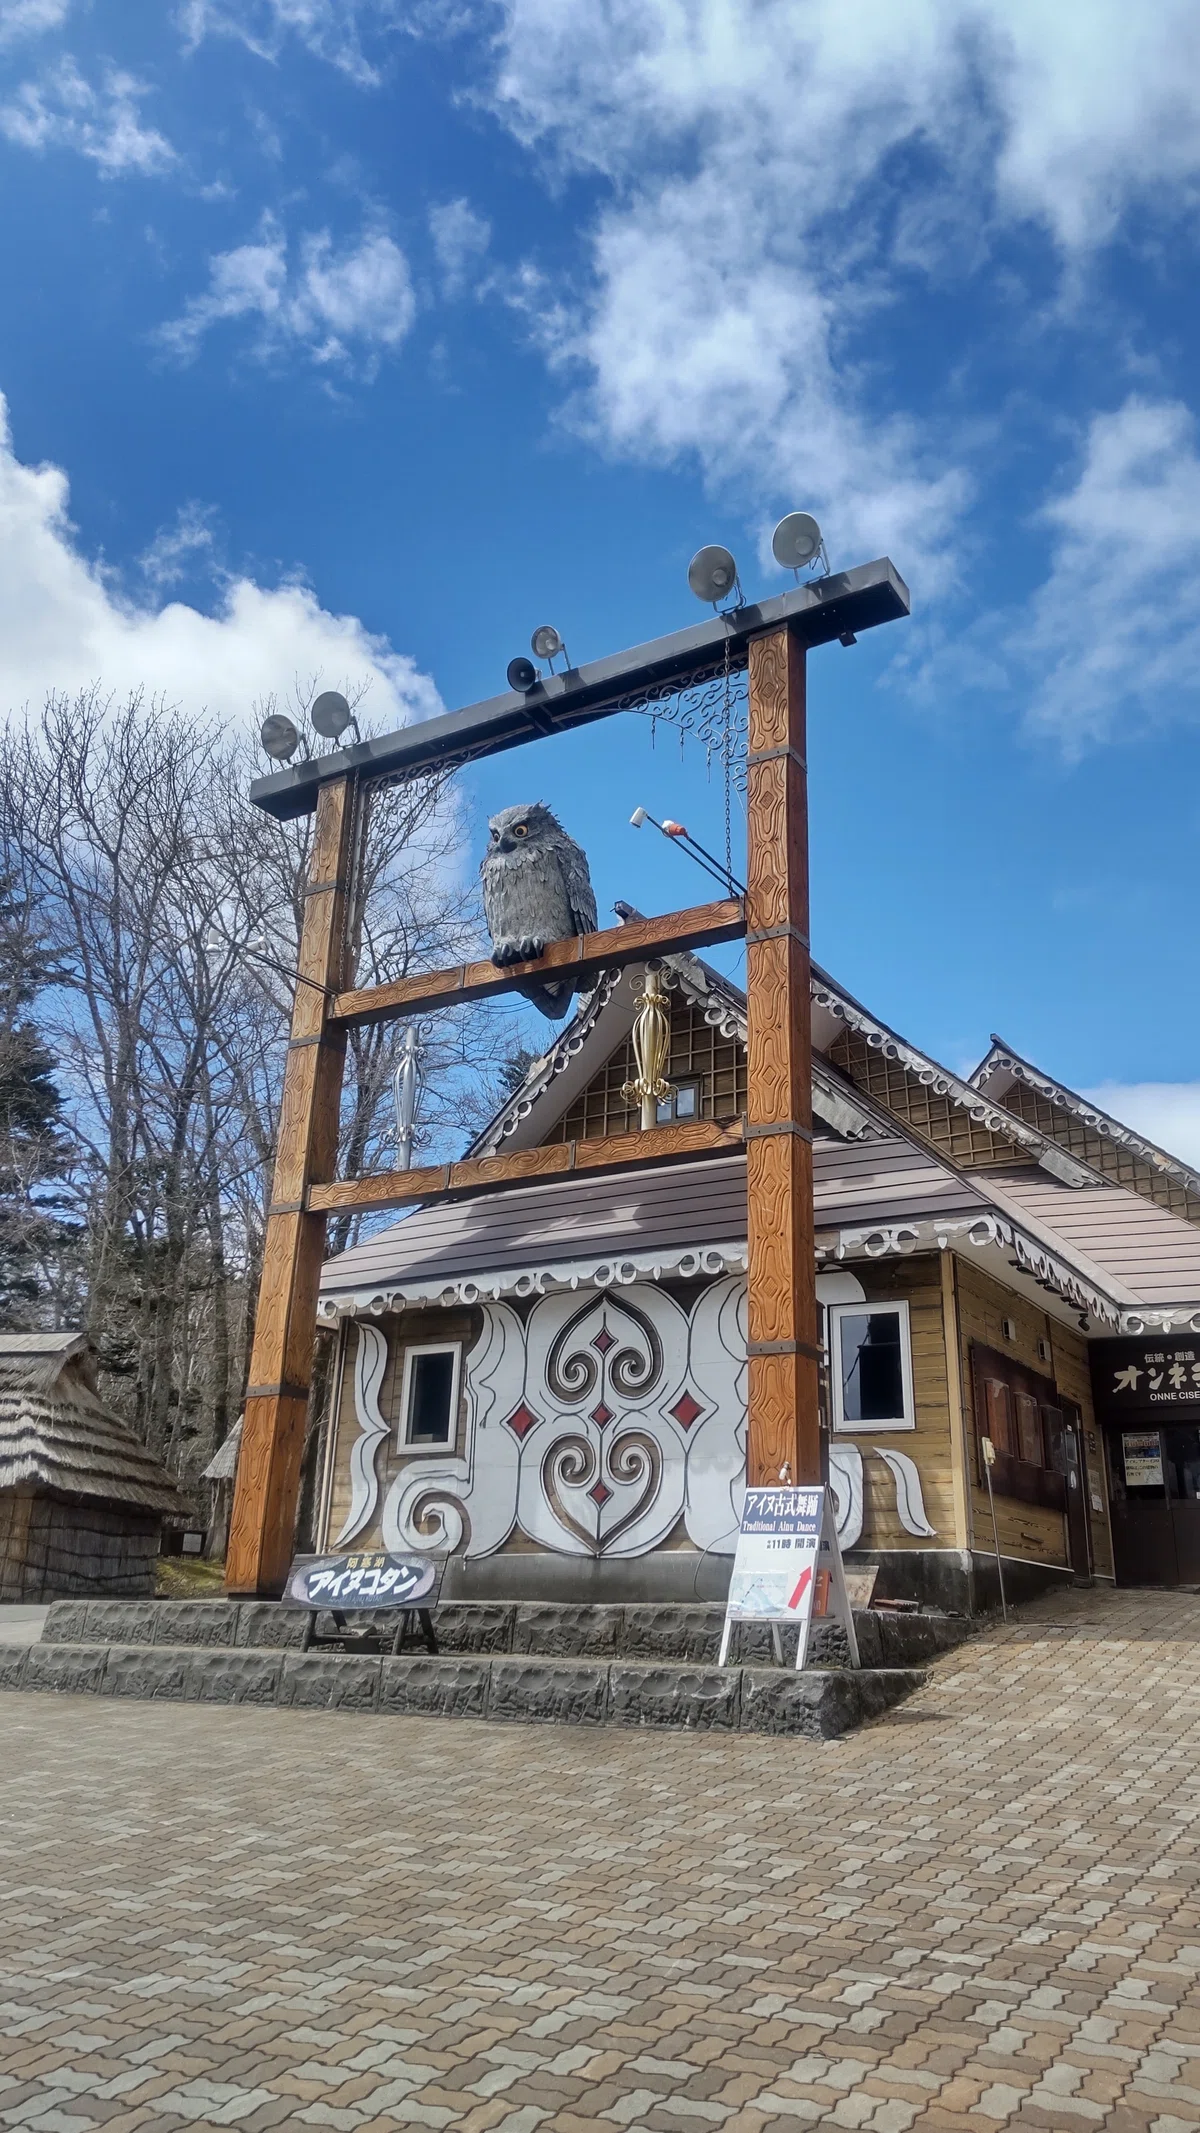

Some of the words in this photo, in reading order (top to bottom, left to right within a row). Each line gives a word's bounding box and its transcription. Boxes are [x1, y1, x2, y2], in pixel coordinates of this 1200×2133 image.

[1144, 1351, 1195, 1363] 伝統・創造
[1149, 1392, 1177, 1401] ONNE
[1178, 1391, 1200, 1400] CISE
[747, 1494, 818, 1516] アイヌ古式舞踊
[743, 1521, 776, 1531] Traditional
[778, 1521, 794, 1531] Ainu
[797, 1521, 816, 1531] Dance
[794, 1538, 816, 1549] 開演
[347, 1557, 385, 1568] 阿寒湖
[309, 1566, 418, 1599] アイヌコタン
